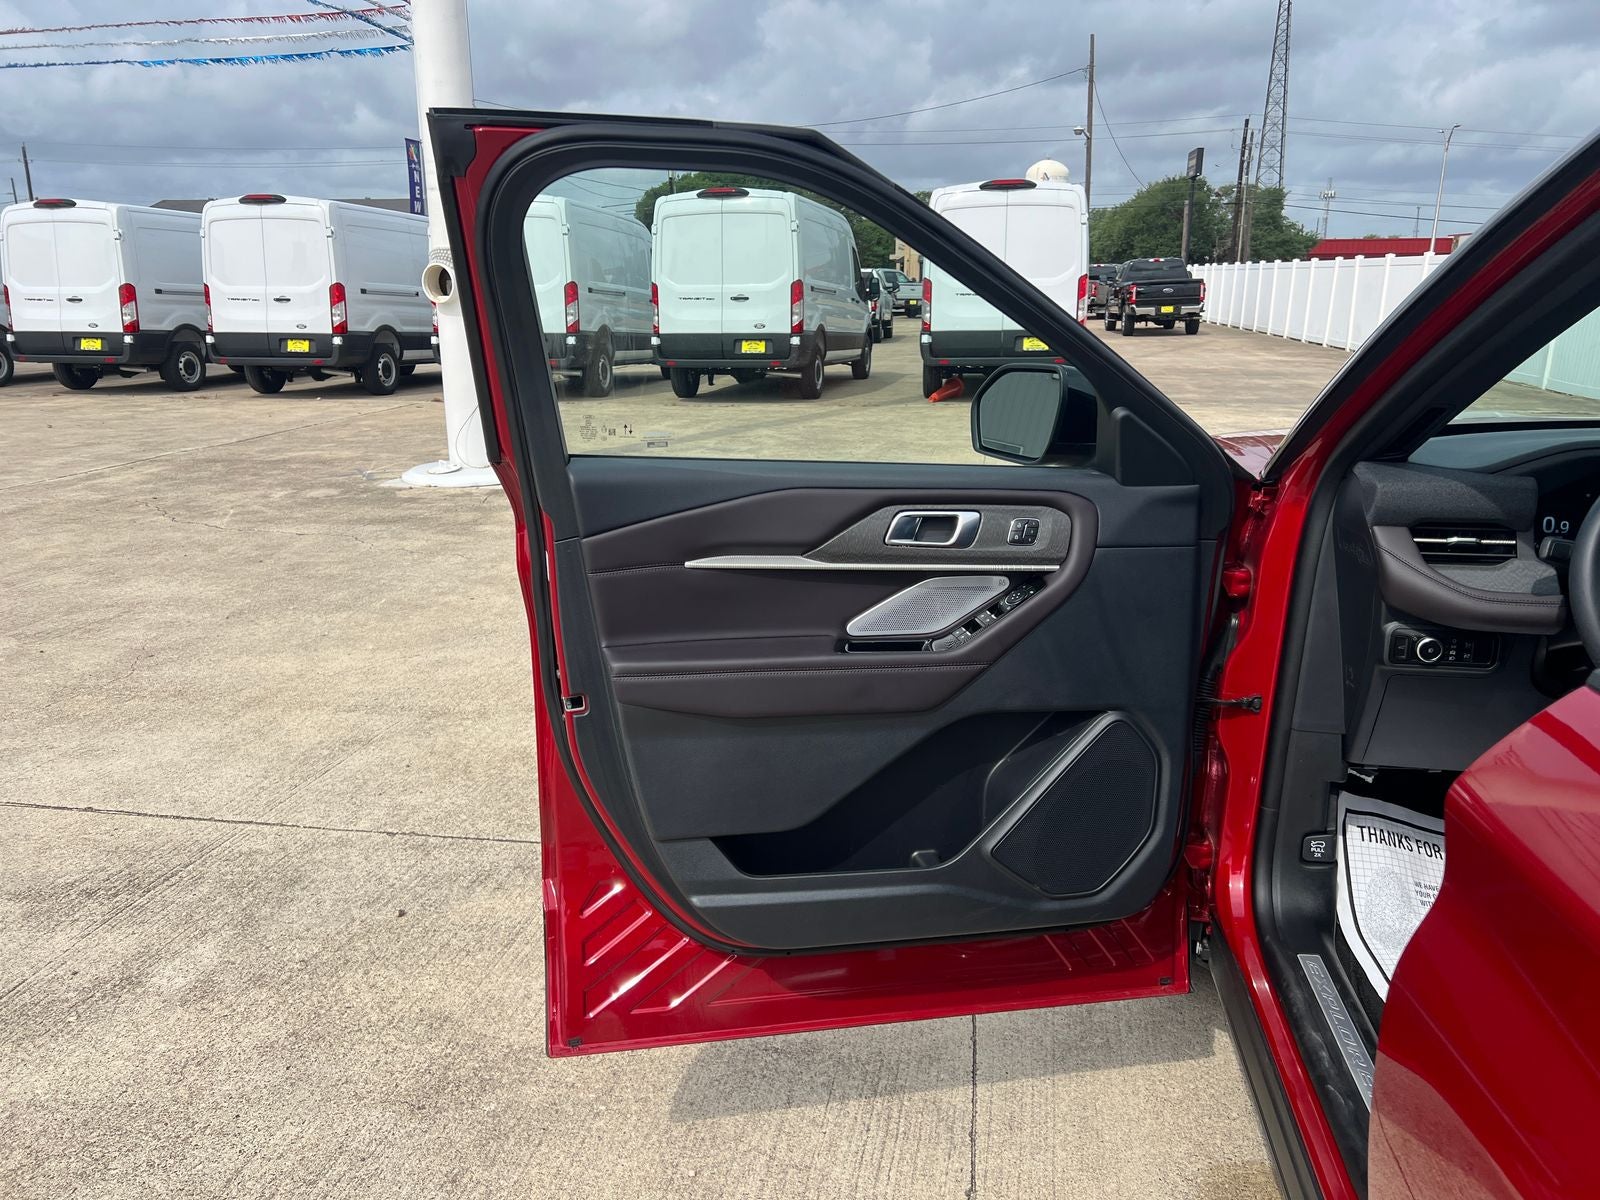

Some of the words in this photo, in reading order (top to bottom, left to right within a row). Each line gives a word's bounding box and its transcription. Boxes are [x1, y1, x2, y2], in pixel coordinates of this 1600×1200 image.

[413, 170, 421, 213] NEW
[1357, 826, 1413, 852] THANKS
[1415, 839, 1444, 860] FOR
[1414, 881, 1423, 889] WE
[1423, 883, 1440, 893] HAVE
[1414, 889, 1432, 899] YOUR
